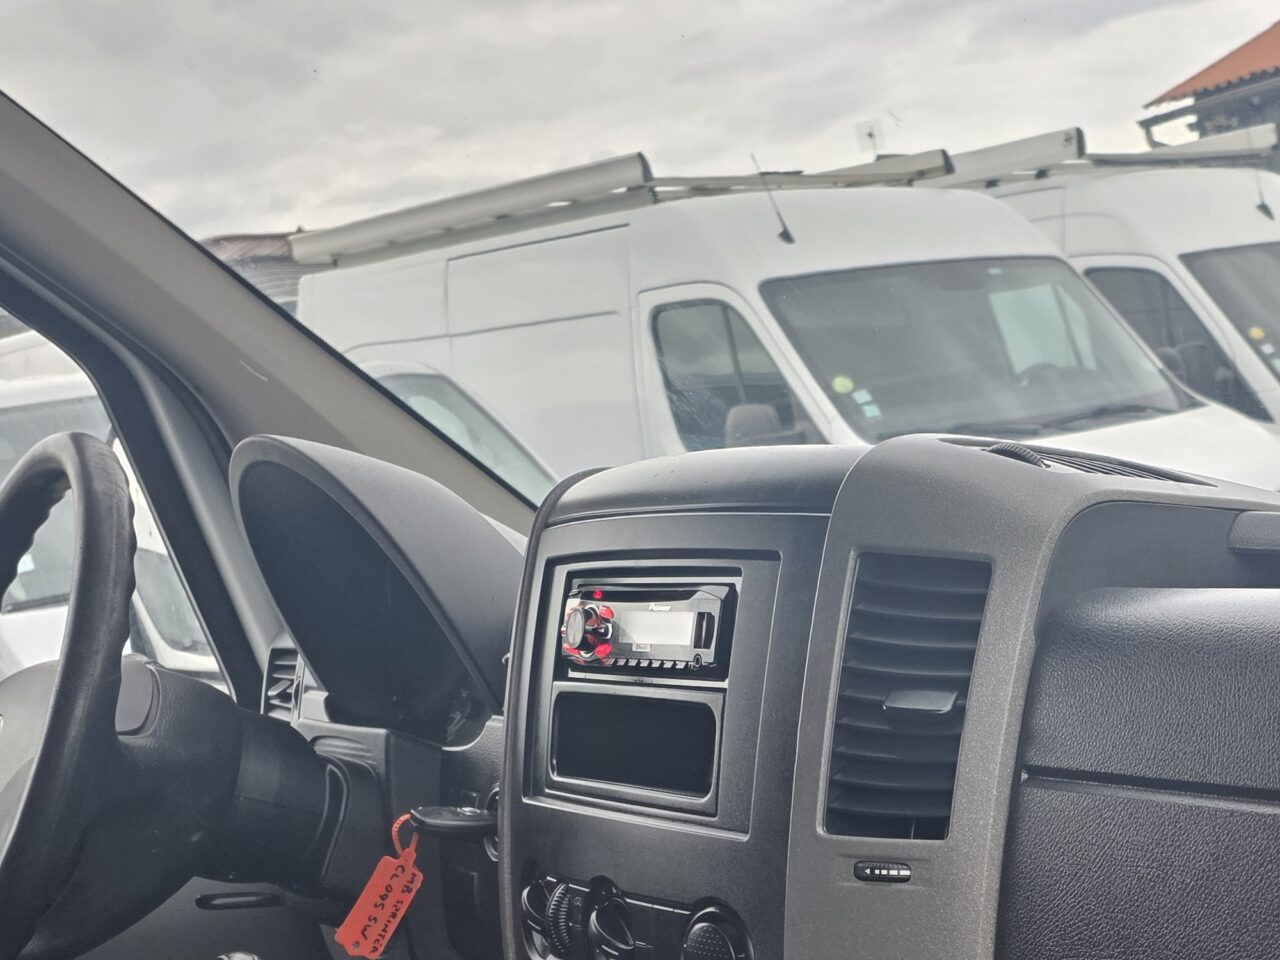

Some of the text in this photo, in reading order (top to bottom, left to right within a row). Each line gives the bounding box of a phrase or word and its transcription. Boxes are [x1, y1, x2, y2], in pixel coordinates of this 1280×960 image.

[361, 864, 405, 940] CL 095 SW
[401, 873, 416, 894] MB
